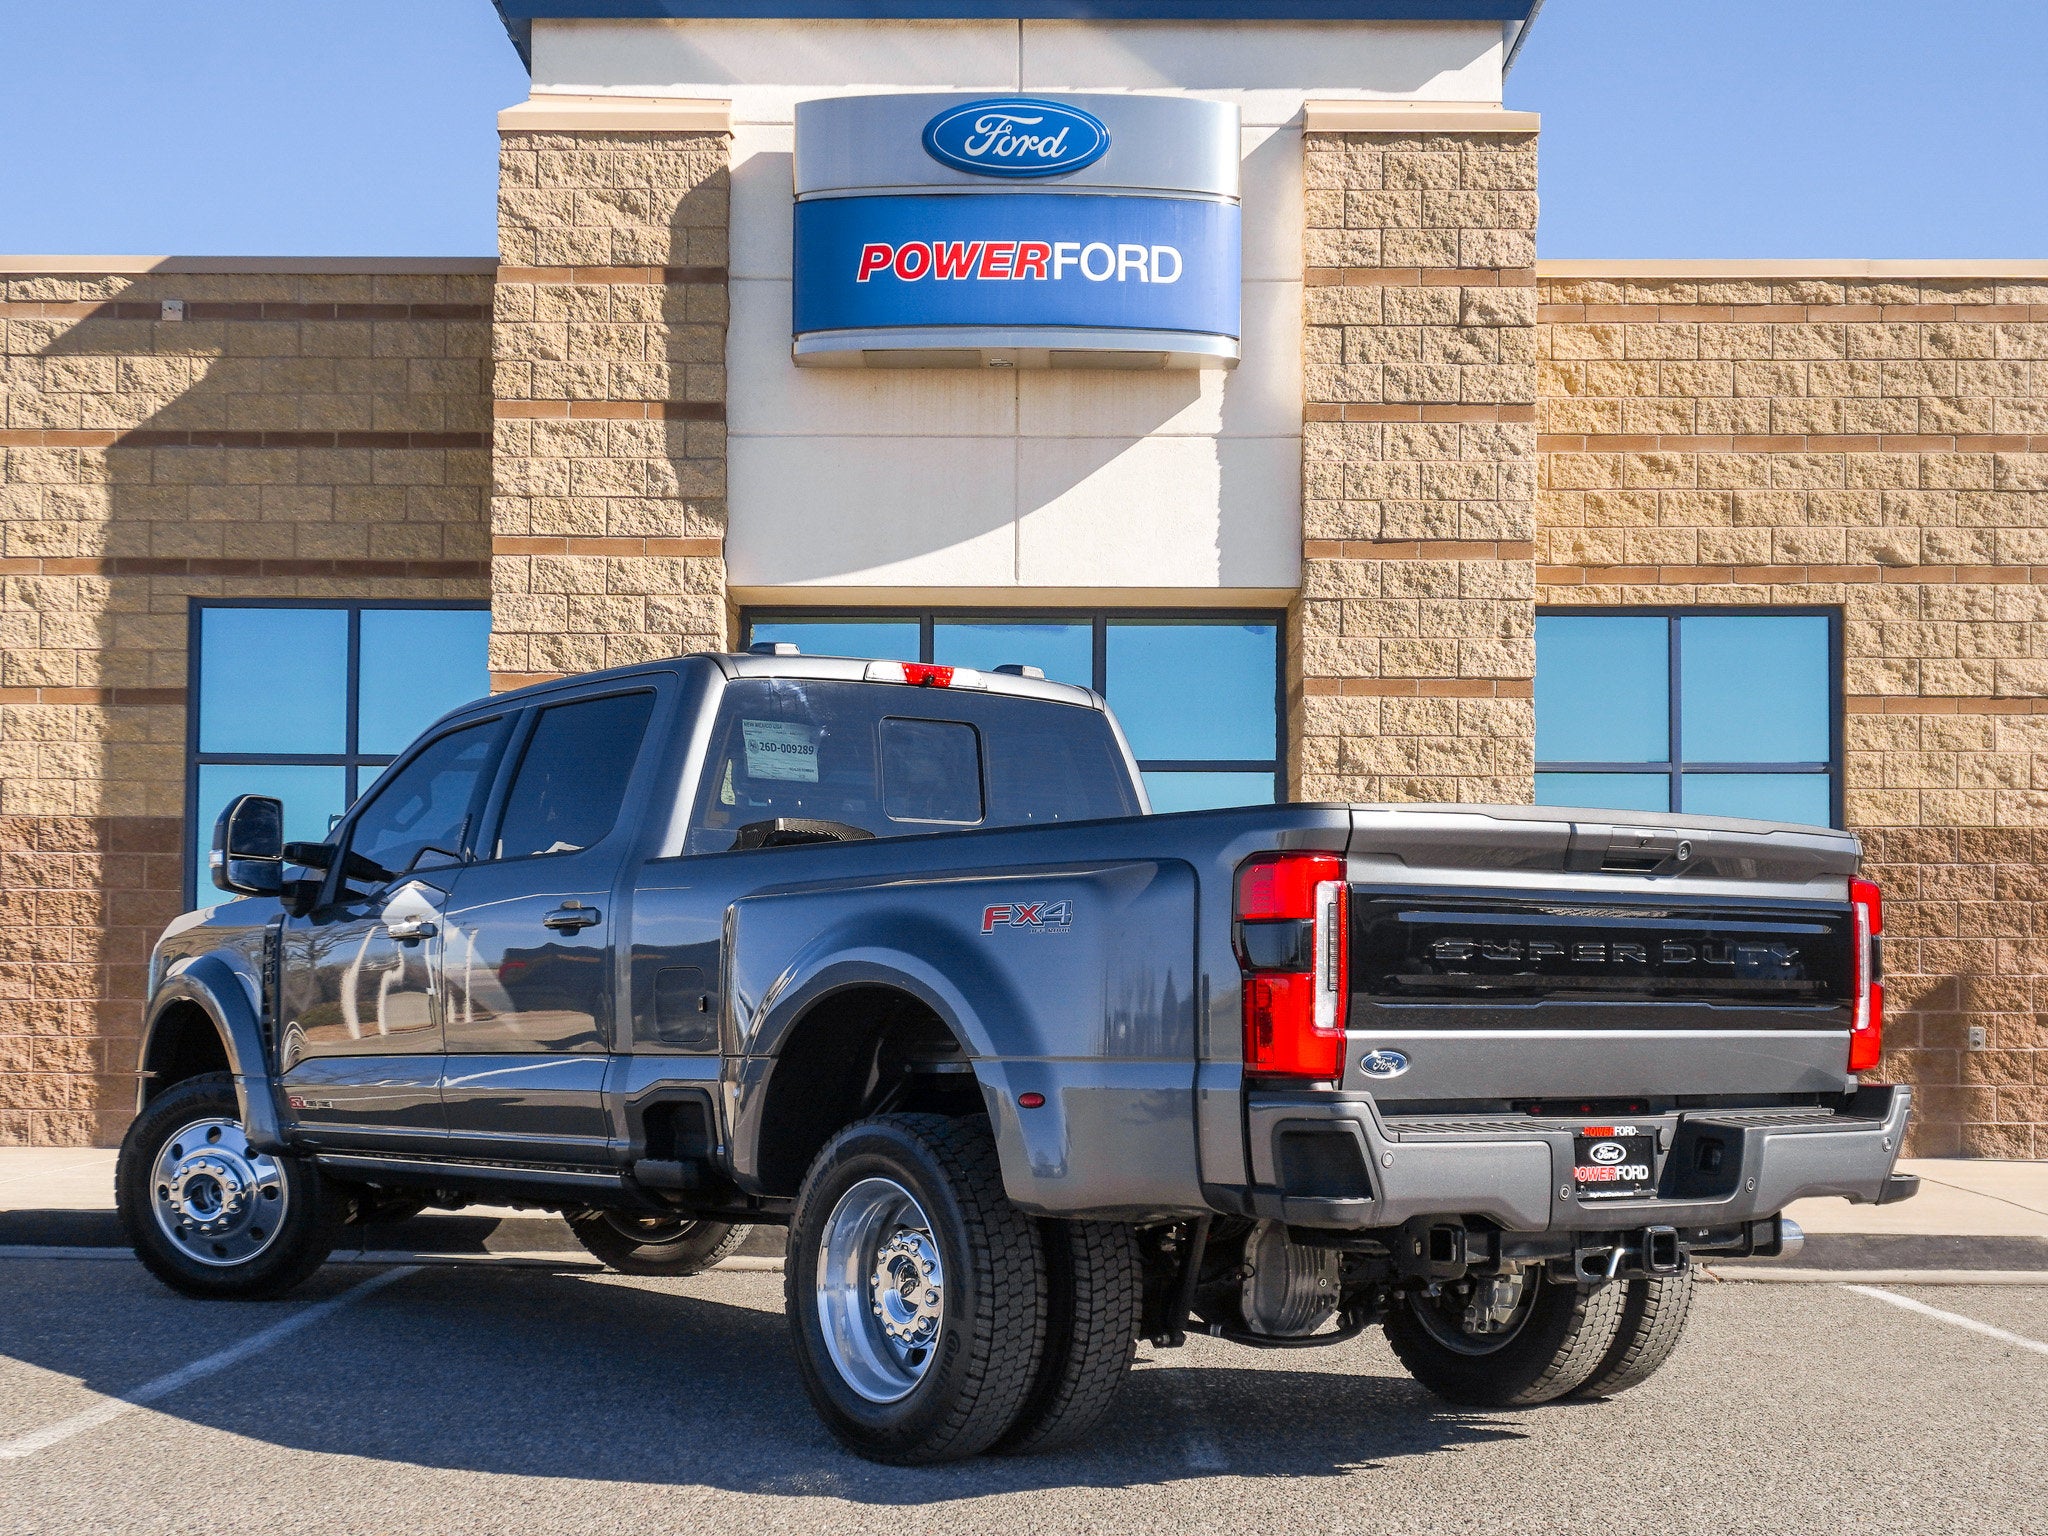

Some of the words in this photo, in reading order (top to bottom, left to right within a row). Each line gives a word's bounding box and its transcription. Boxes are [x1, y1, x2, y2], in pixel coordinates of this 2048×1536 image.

[963, 113, 1070, 159] Ford
[760, 742, 814, 755] 26D-009289
[981, 900, 1073, 935] FX4
[1431, 937, 1648, 963] SUPER
[1662, 939, 1799, 966] DUTY
[1373, 1056, 1399, 1070] Ford
[1597, 1147, 1619, 1160] Ford
